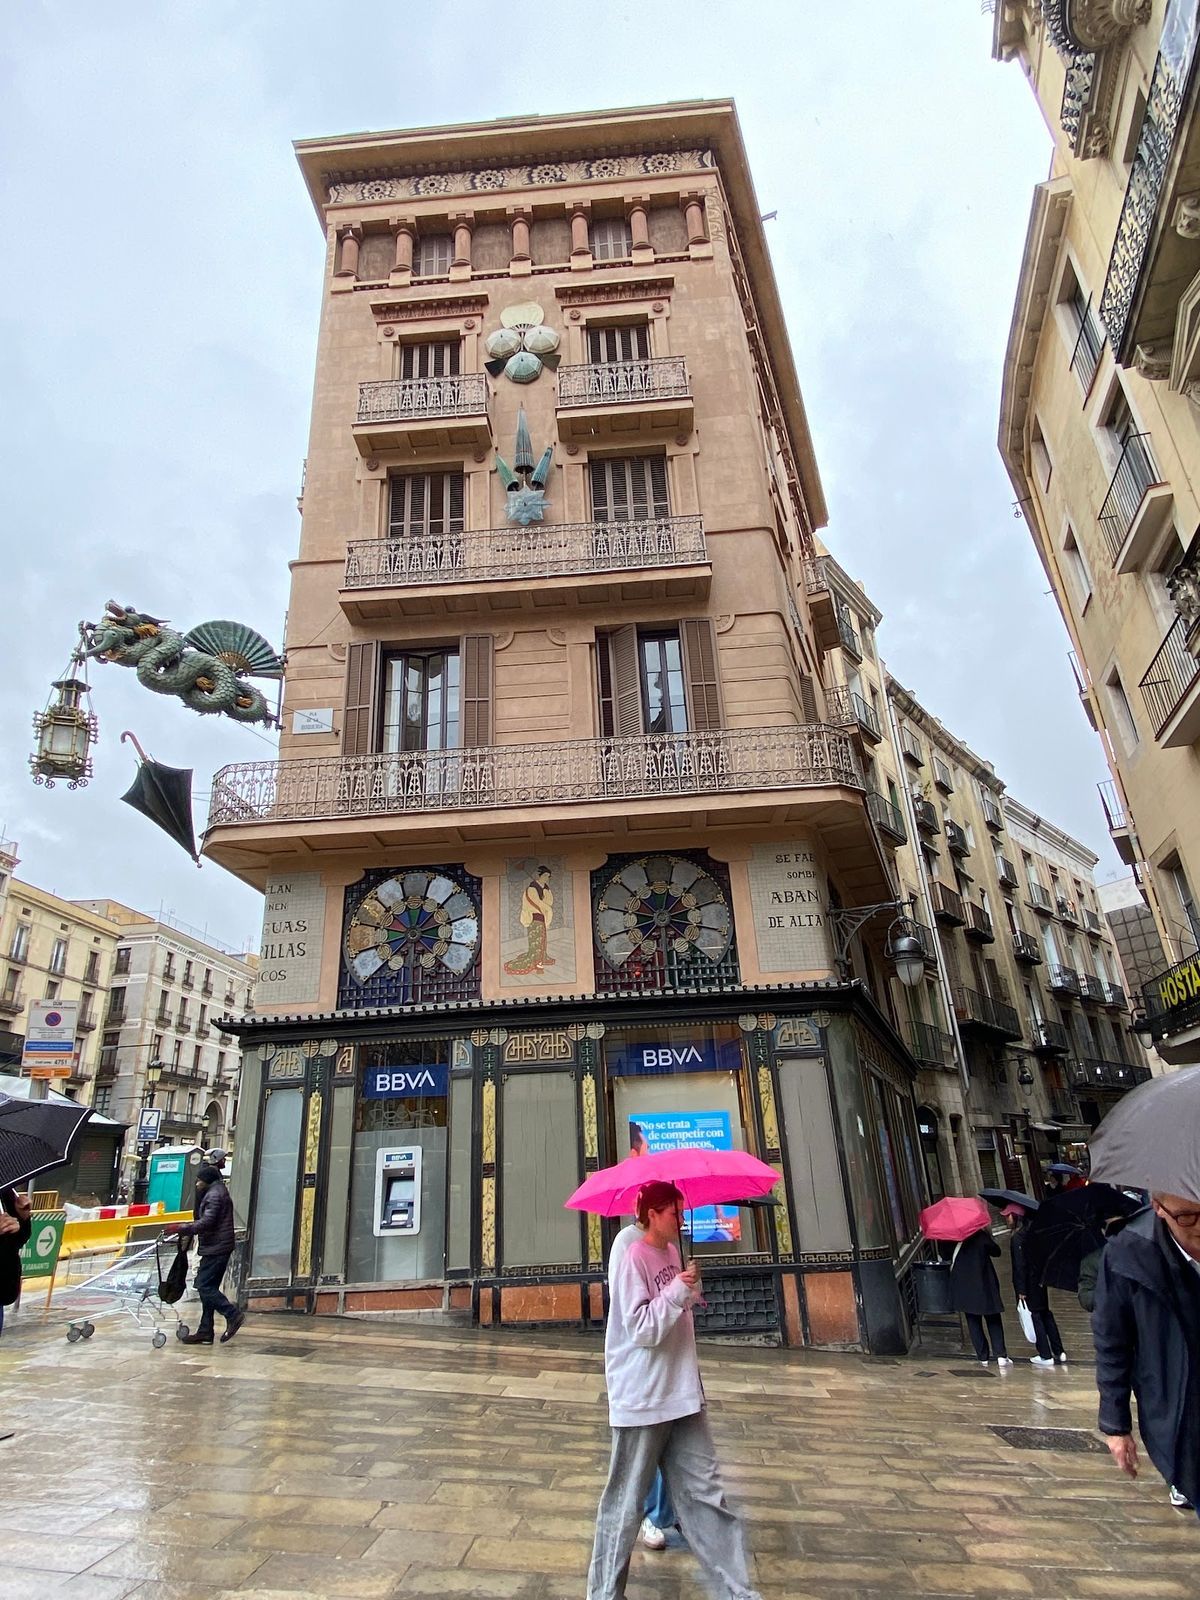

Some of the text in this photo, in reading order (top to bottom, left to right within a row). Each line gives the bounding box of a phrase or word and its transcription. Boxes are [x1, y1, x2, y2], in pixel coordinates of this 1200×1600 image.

[775, 854, 791, 863] SE
[266, 903, 287, 911] NEN
[768, 914, 823, 929] DE ALTA
[1159, 959, 1200, 1010] HOSTA
[643, 1045, 703, 1067] BBVA
[376, 1069, 436, 1092] BBVA
[667, 1120, 691, 1129] trata
[648, 1128, 724, 1141] de competir con
[650, 1139, 715, 1150] otros bancos,
